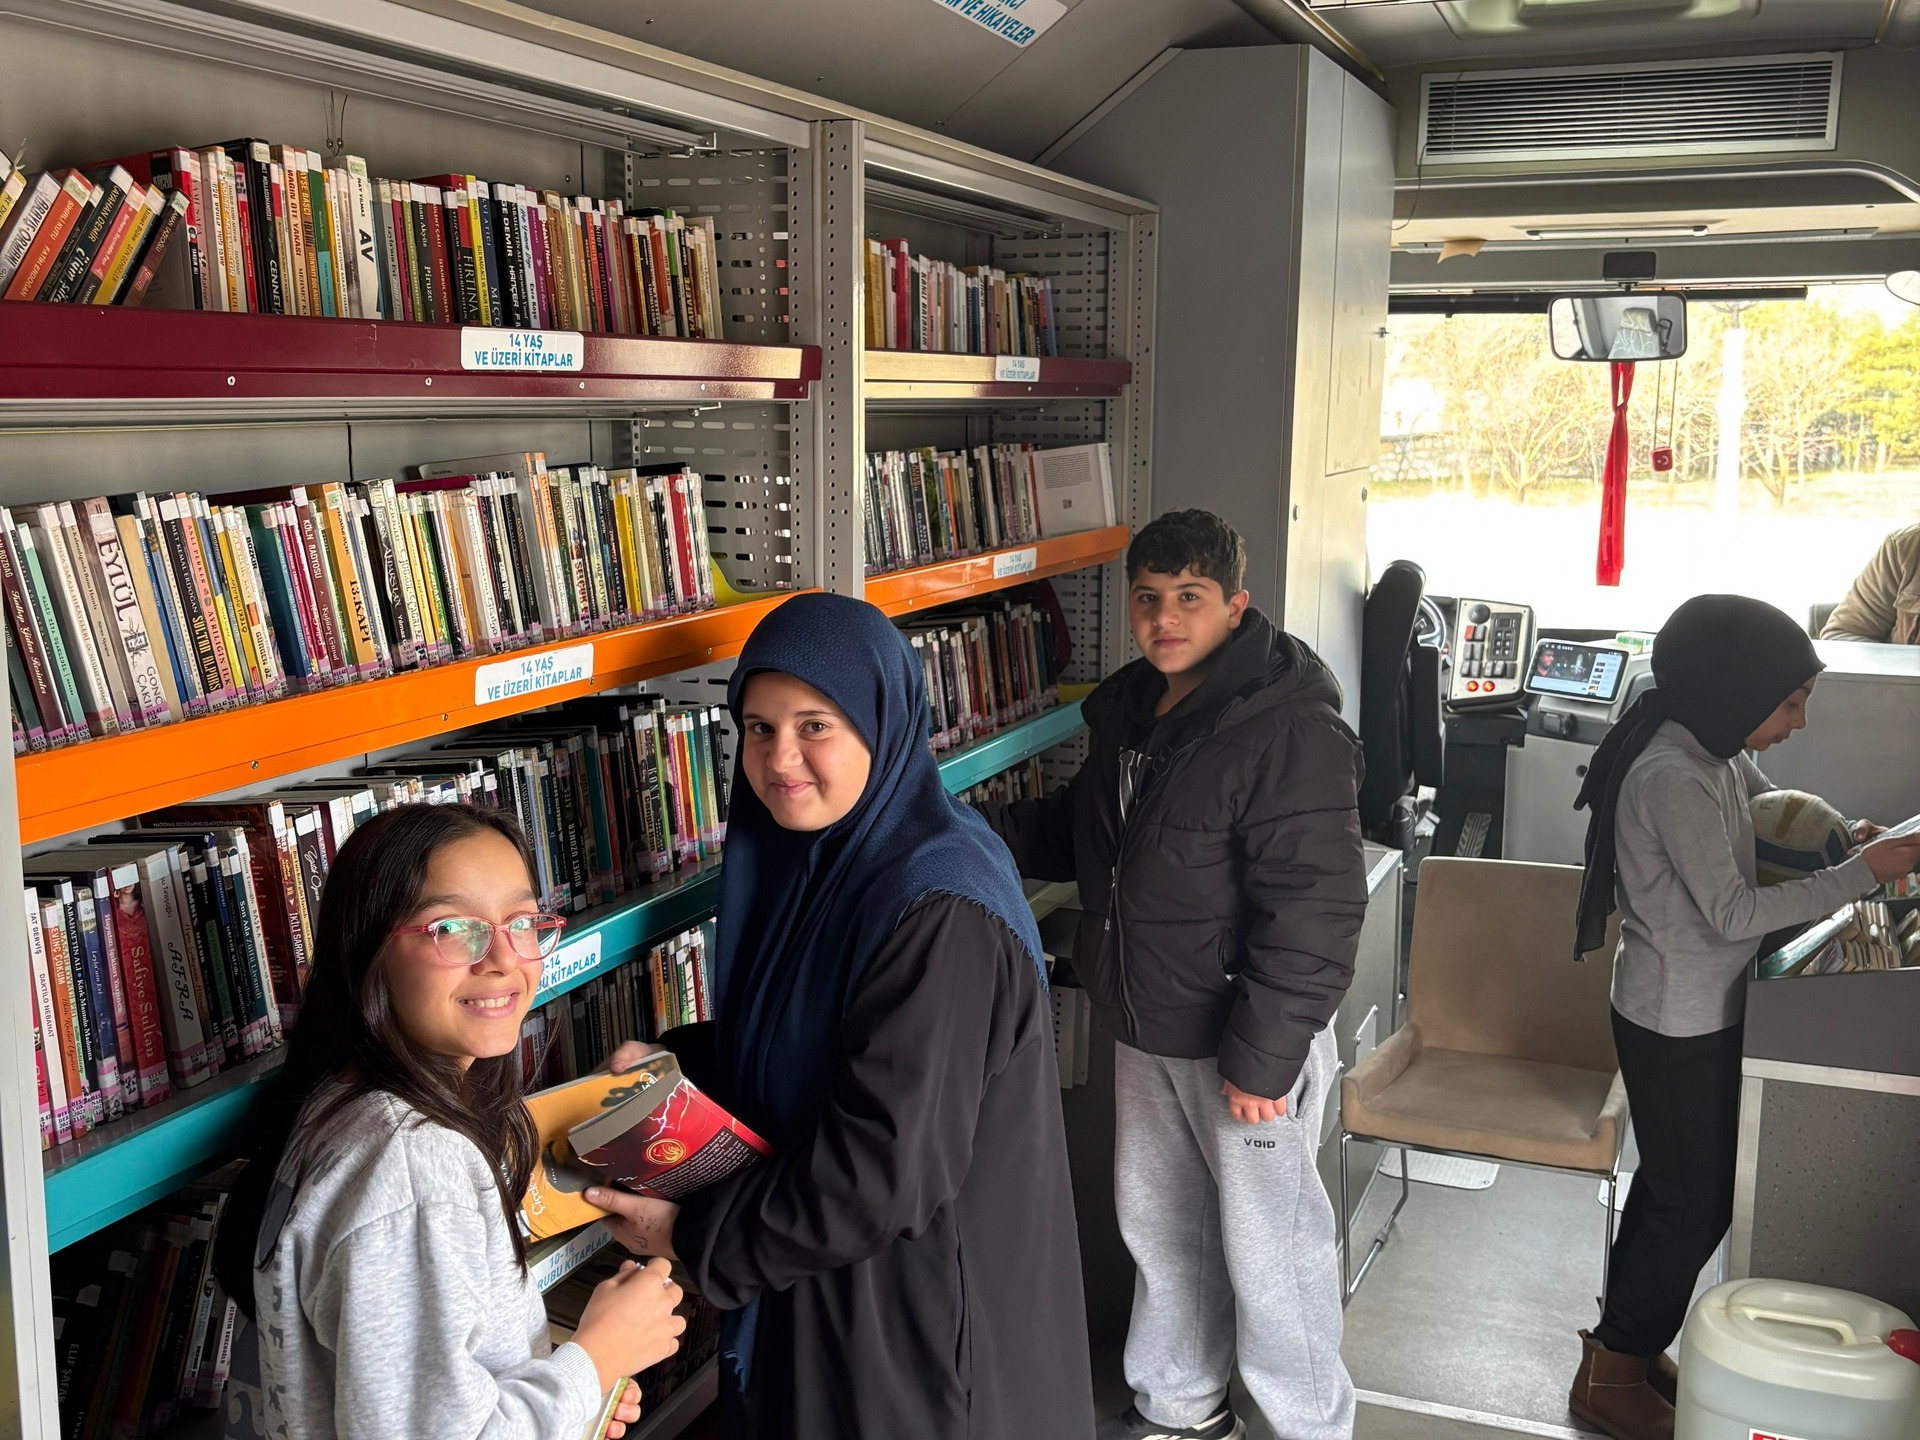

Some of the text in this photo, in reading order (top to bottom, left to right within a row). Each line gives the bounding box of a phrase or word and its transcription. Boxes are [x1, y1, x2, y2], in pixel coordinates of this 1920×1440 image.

[973, 4, 1036, 44] HİKAYELER
[49, 221, 64, 241] KUTU
[358, 227, 373, 263] AV
[502, 216, 513, 256] DEMİR
[35, 244, 52, 266] FATİH
[269, 259, 280, 308] CENNET
[461, 254, 479, 312] FIRTINA
[475, 348, 572, 366] VE ÜZERİ KİTAPLAR
[510, 334, 542, 350] 14 YAŞ
[302, 518, 314, 540] KÖLN
[193, 549, 205, 584] PERKER
[245, 536, 258, 569] BOZKIR
[307, 543, 322, 578] RADYOSU
[97, 535, 139, 621] EYLÜL
[175, 543, 188, 571] KEMAL
[182, 572, 200, 613] ERDOĞAN
[203, 654, 222, 690] ALPARS
[347, 578, 372, 643] 13.KAPI
[521, 656, 553, 675] 14 YAŞ
[145, 665, 164, 705] GONC
[488, 667, 582, 700] VE ÜZERİ KİTAPLAR
[569, 823, 581, 887] BUKET UZUNER
[31, 927, 42, 954] DERVİŞ
[103, 914, 114, 946] Hayatın
[291, 933, 306, 965] SARMAL
[542, 954, 560, 972] -14
[166, 940, 195, 1022] AFRA
[249, 964, 264, 999] Livaneli
[552, 953, 596, 984] KİTAPLAR
[39, 973, 49, 1003] DAKTİLO
[128, 945, 158, 1057] Safiye Sultan
[43, 1005, 54, 1037] NEBAHAT
[79, 998, 89, 1026] Mantolu
[83, 1028, 94, 1061] Madonna
[1244, 1138, 1275, 1148] VOID
[549, 1242, 574, 1268] 10-14
[565, 1232, 608, 1272] KİTAPLAR
[67, 1343, 80, 1366] ELİF
